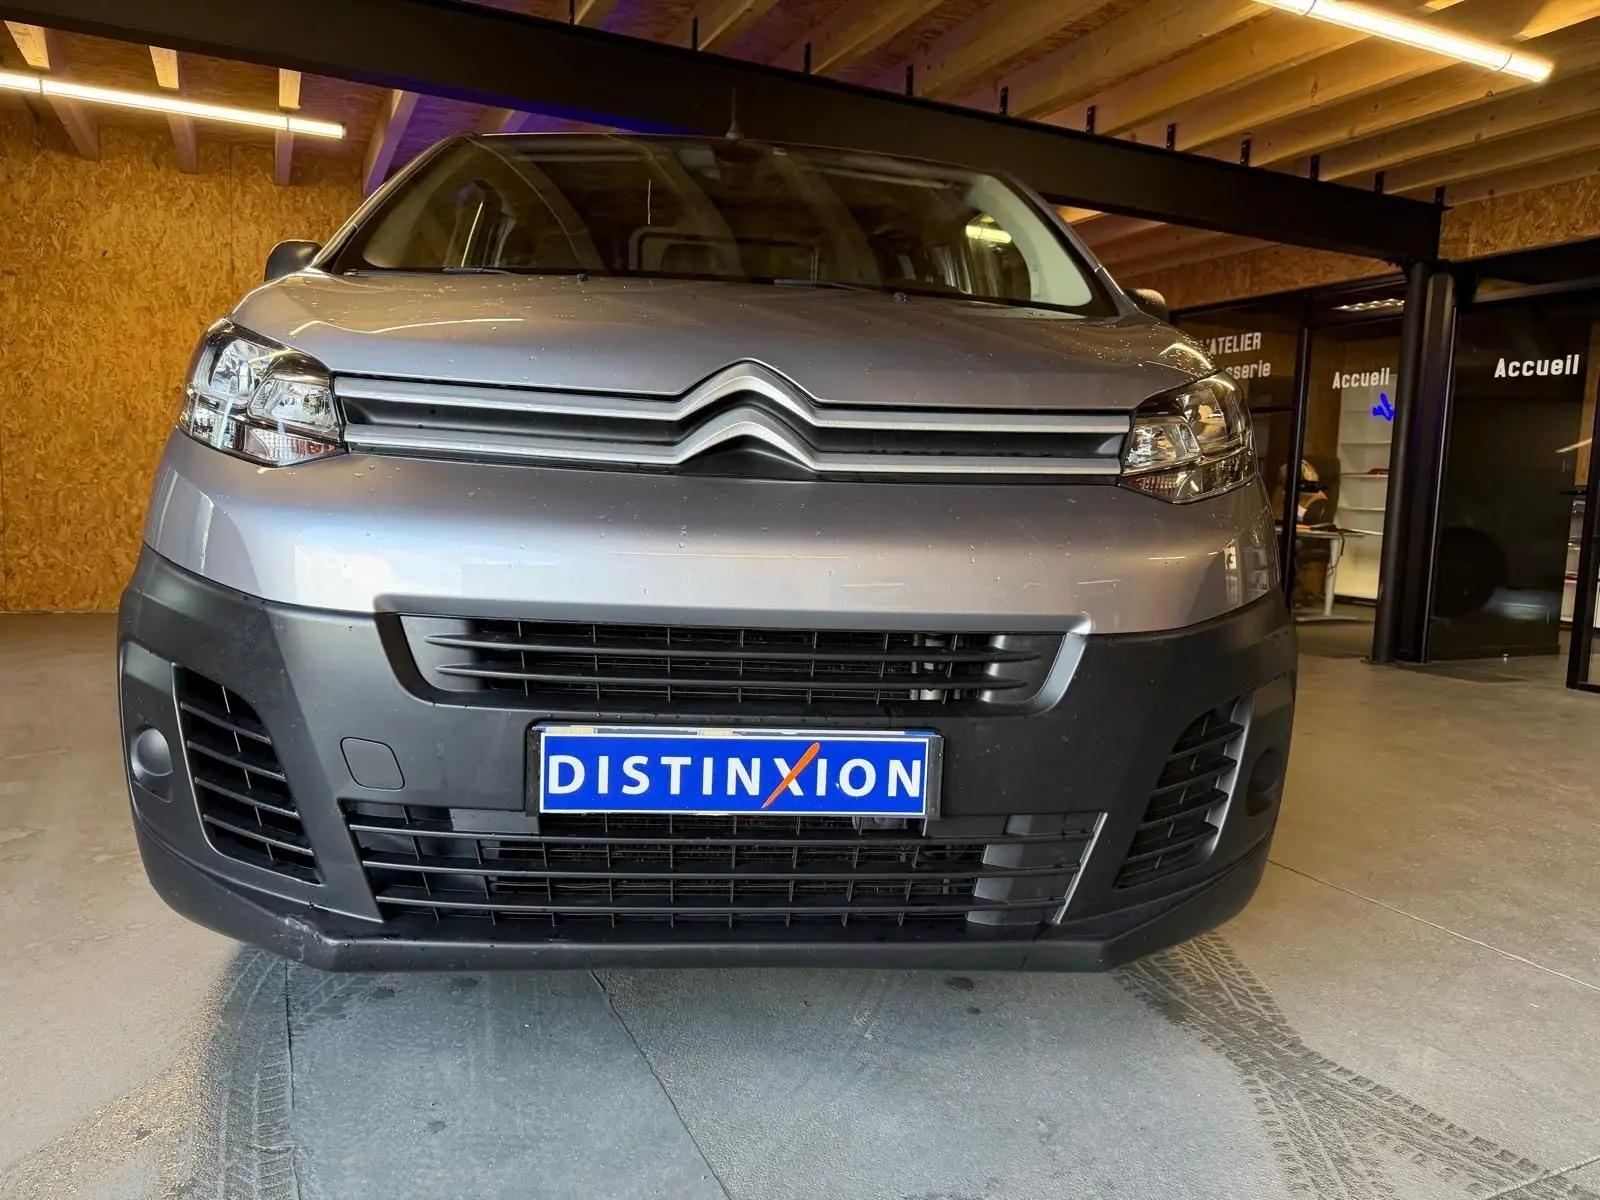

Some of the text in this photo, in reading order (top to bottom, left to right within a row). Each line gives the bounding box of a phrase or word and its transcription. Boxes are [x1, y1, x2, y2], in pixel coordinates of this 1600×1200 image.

[1200, 332, 1262, 355] 'ATELIER
[1225, 360, 1271, 380] sserie
[1493, 354, 1580, 378] Accueil
[1332, 367, 1390, 389] Accueil
[548, 742, 921, 808] DISTINXION
